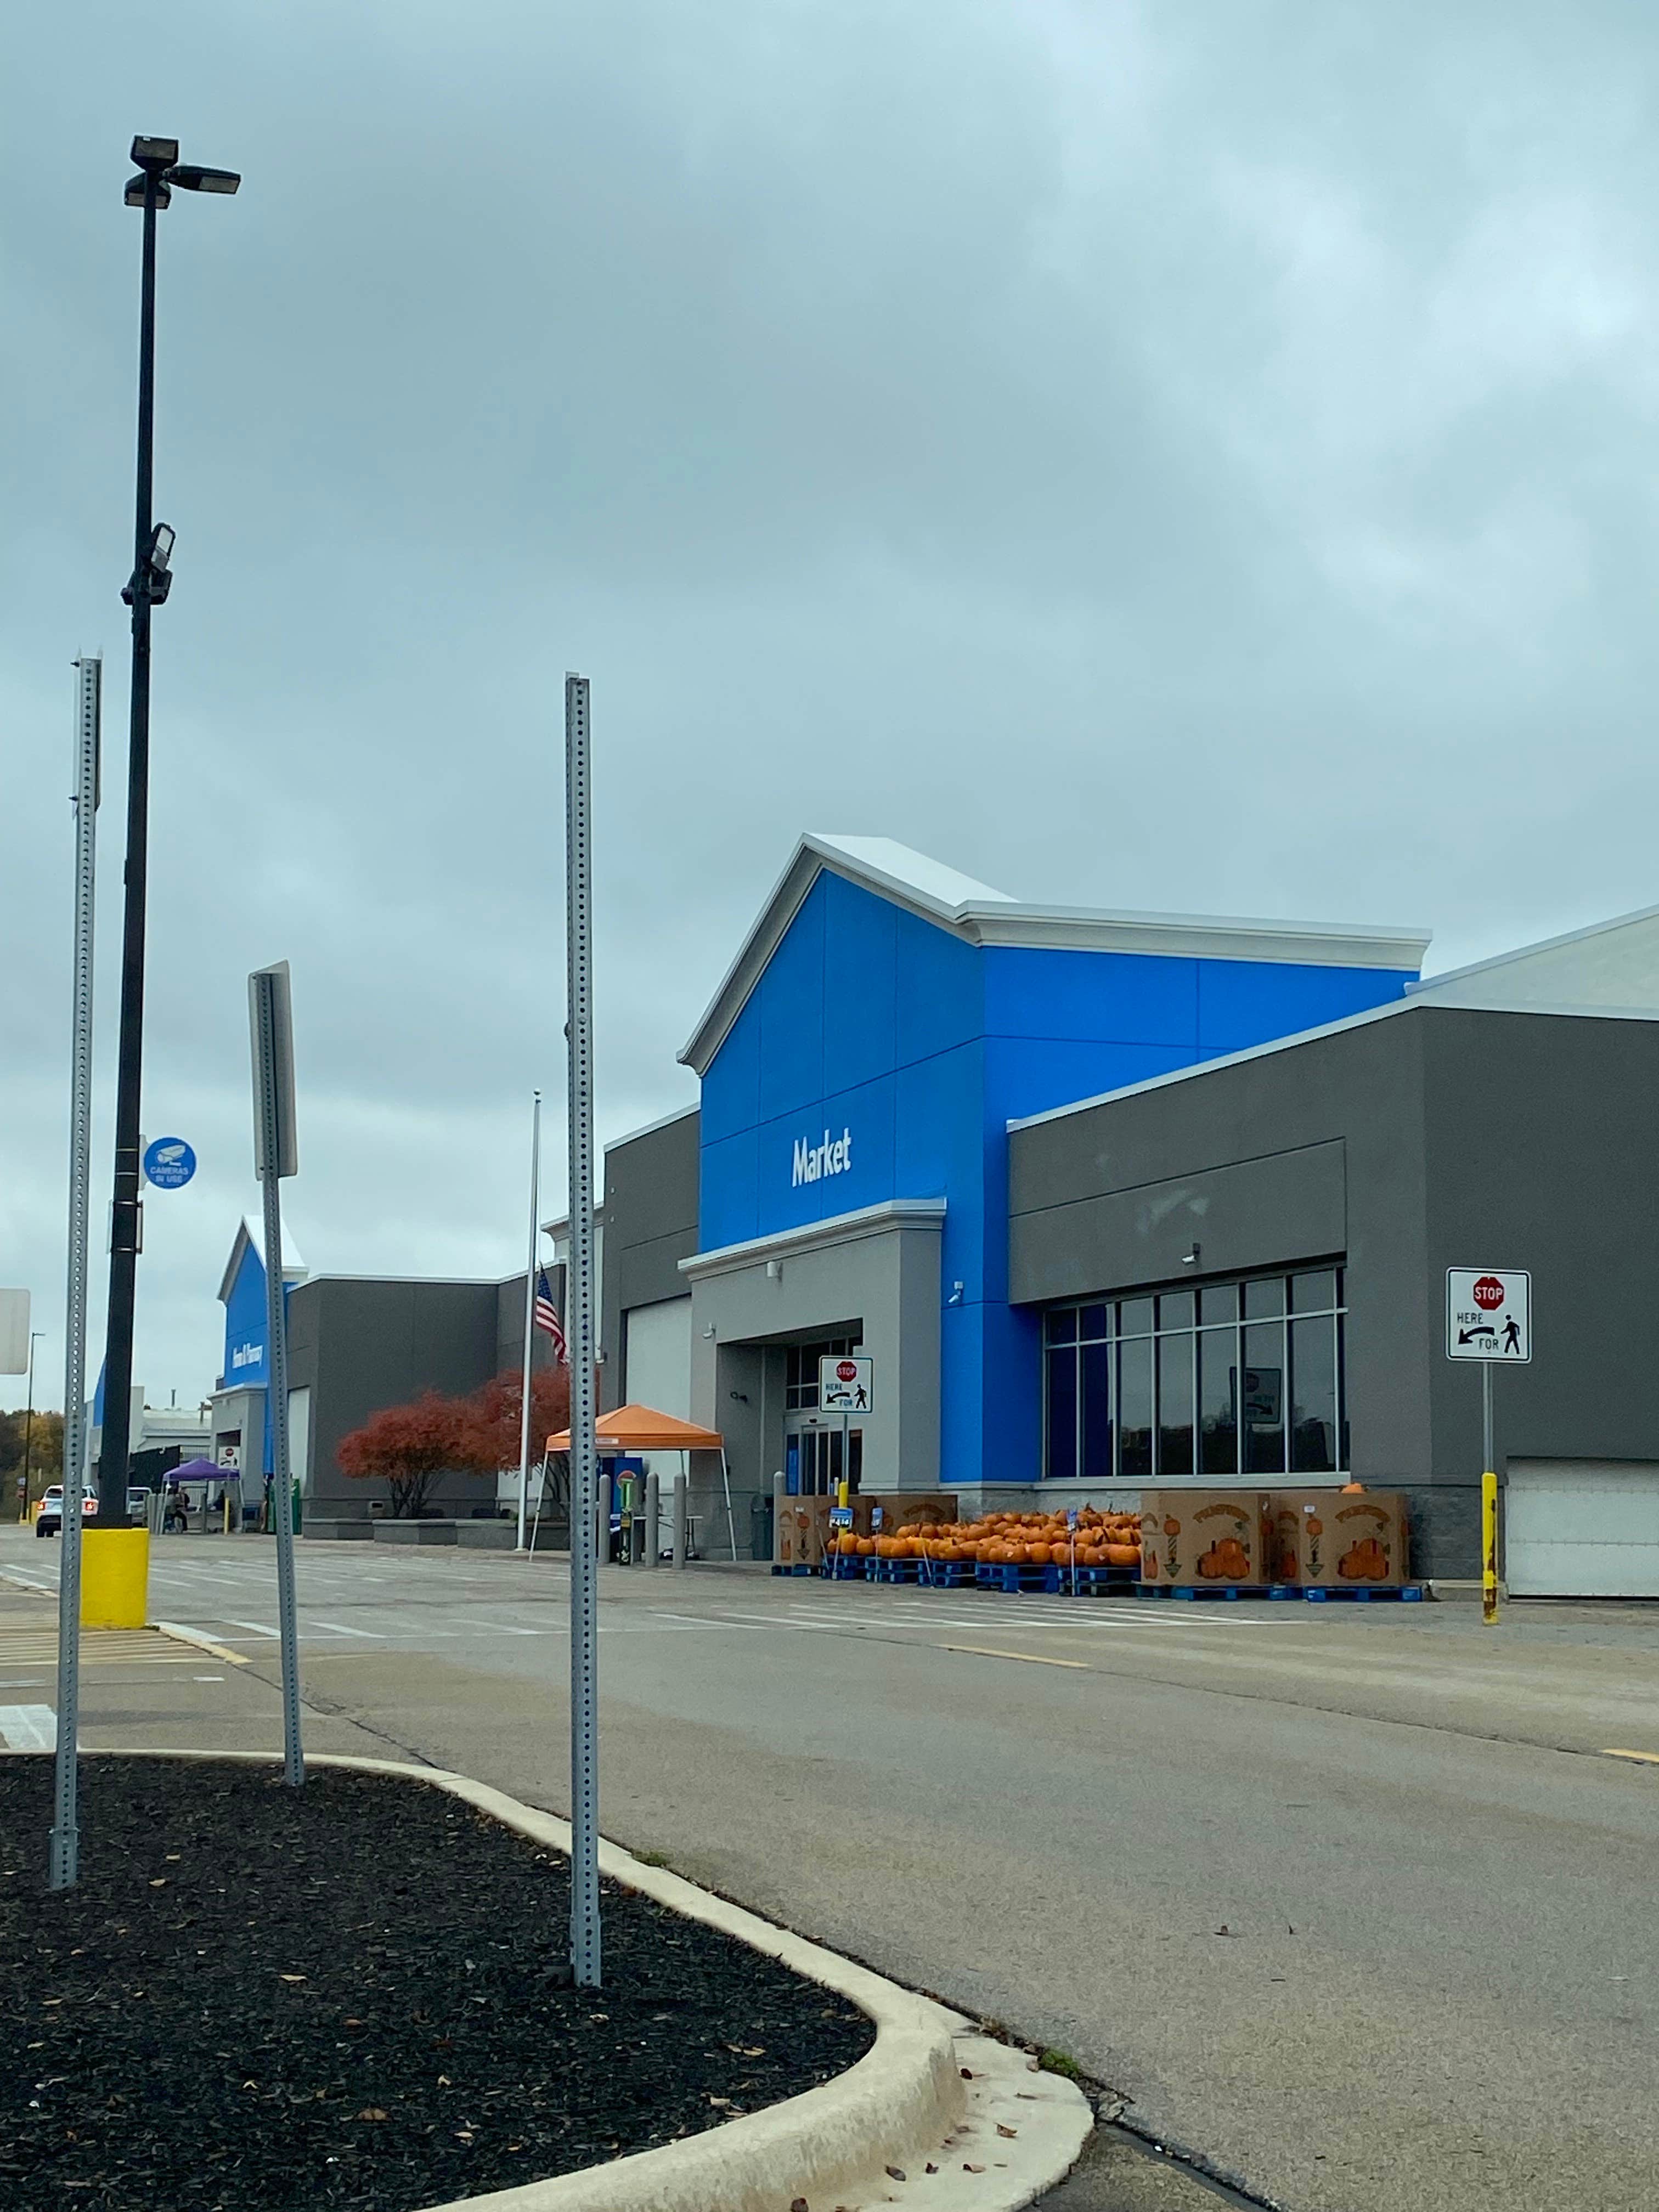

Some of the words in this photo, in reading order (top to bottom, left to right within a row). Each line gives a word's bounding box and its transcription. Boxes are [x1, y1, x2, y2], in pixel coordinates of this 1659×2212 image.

[792, 1127, 851, 1188] Market
[1475, 1286, 1503, 1300] STOP
[1457, 1312, 1483, 1324] HERE
[1479, 1338, 1499, 1350] FOR
[837, 1367, 855, 1376] STOP
